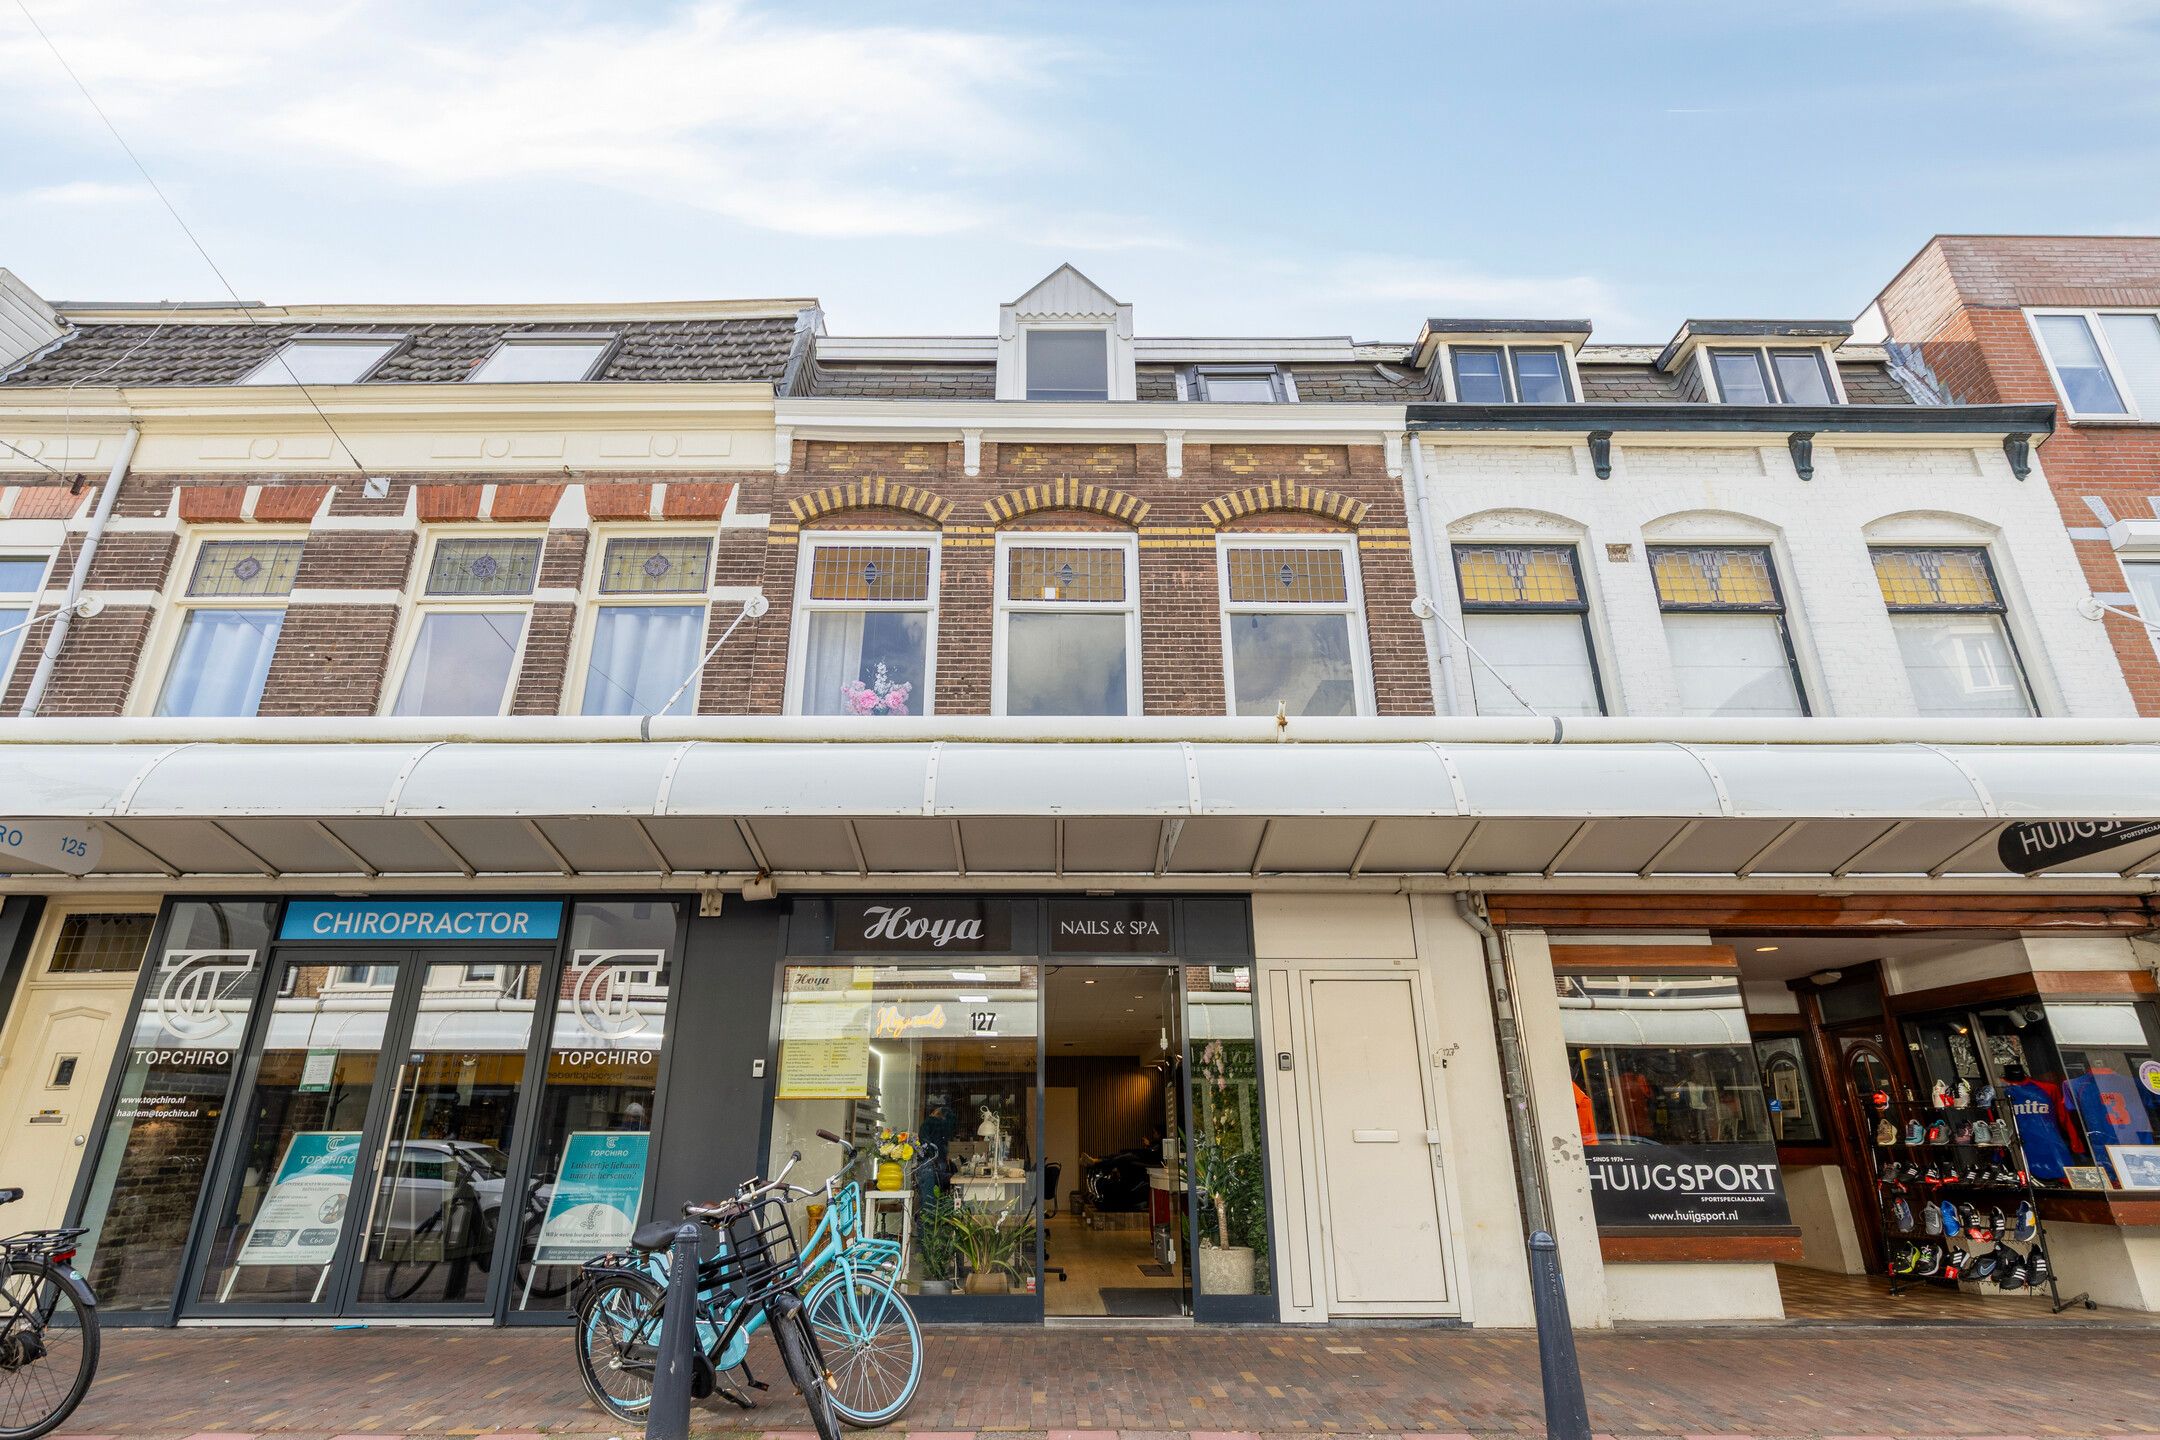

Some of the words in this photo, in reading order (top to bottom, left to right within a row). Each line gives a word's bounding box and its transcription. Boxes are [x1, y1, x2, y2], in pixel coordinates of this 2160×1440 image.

[61, 836, 87, 857] 125
[312, 911, 529, 935] CHIROPRACTOR
[863, 905, 985, 948] Hoya
[1061, 920, 1109, 935] NAILS
[1113, 920, 1126, 935] &
[1129, 920, 1160, 935] SPA
[970, 1012, 996, 1032] 127
[135, 1050, 230, 1066] TOPCHIRO
[558, 1050, 653, 1066] TOPCHIRO
[121, 1096, 187, 1105] www.topchiro.nl
[2100, 1091, 2132, 1125] 3
[116, 1109, 199, 1119] haarlem@topchiro.nl
[300, 1155, 356, 1165] TOPCHIRO
[590, 1149, 629, 1157] TOPCHIRO
[1586, 1164, 1776, 1191] HUIJGSPORT
[1648, 1210, 1738, 1224] www.huijgsport.nl
